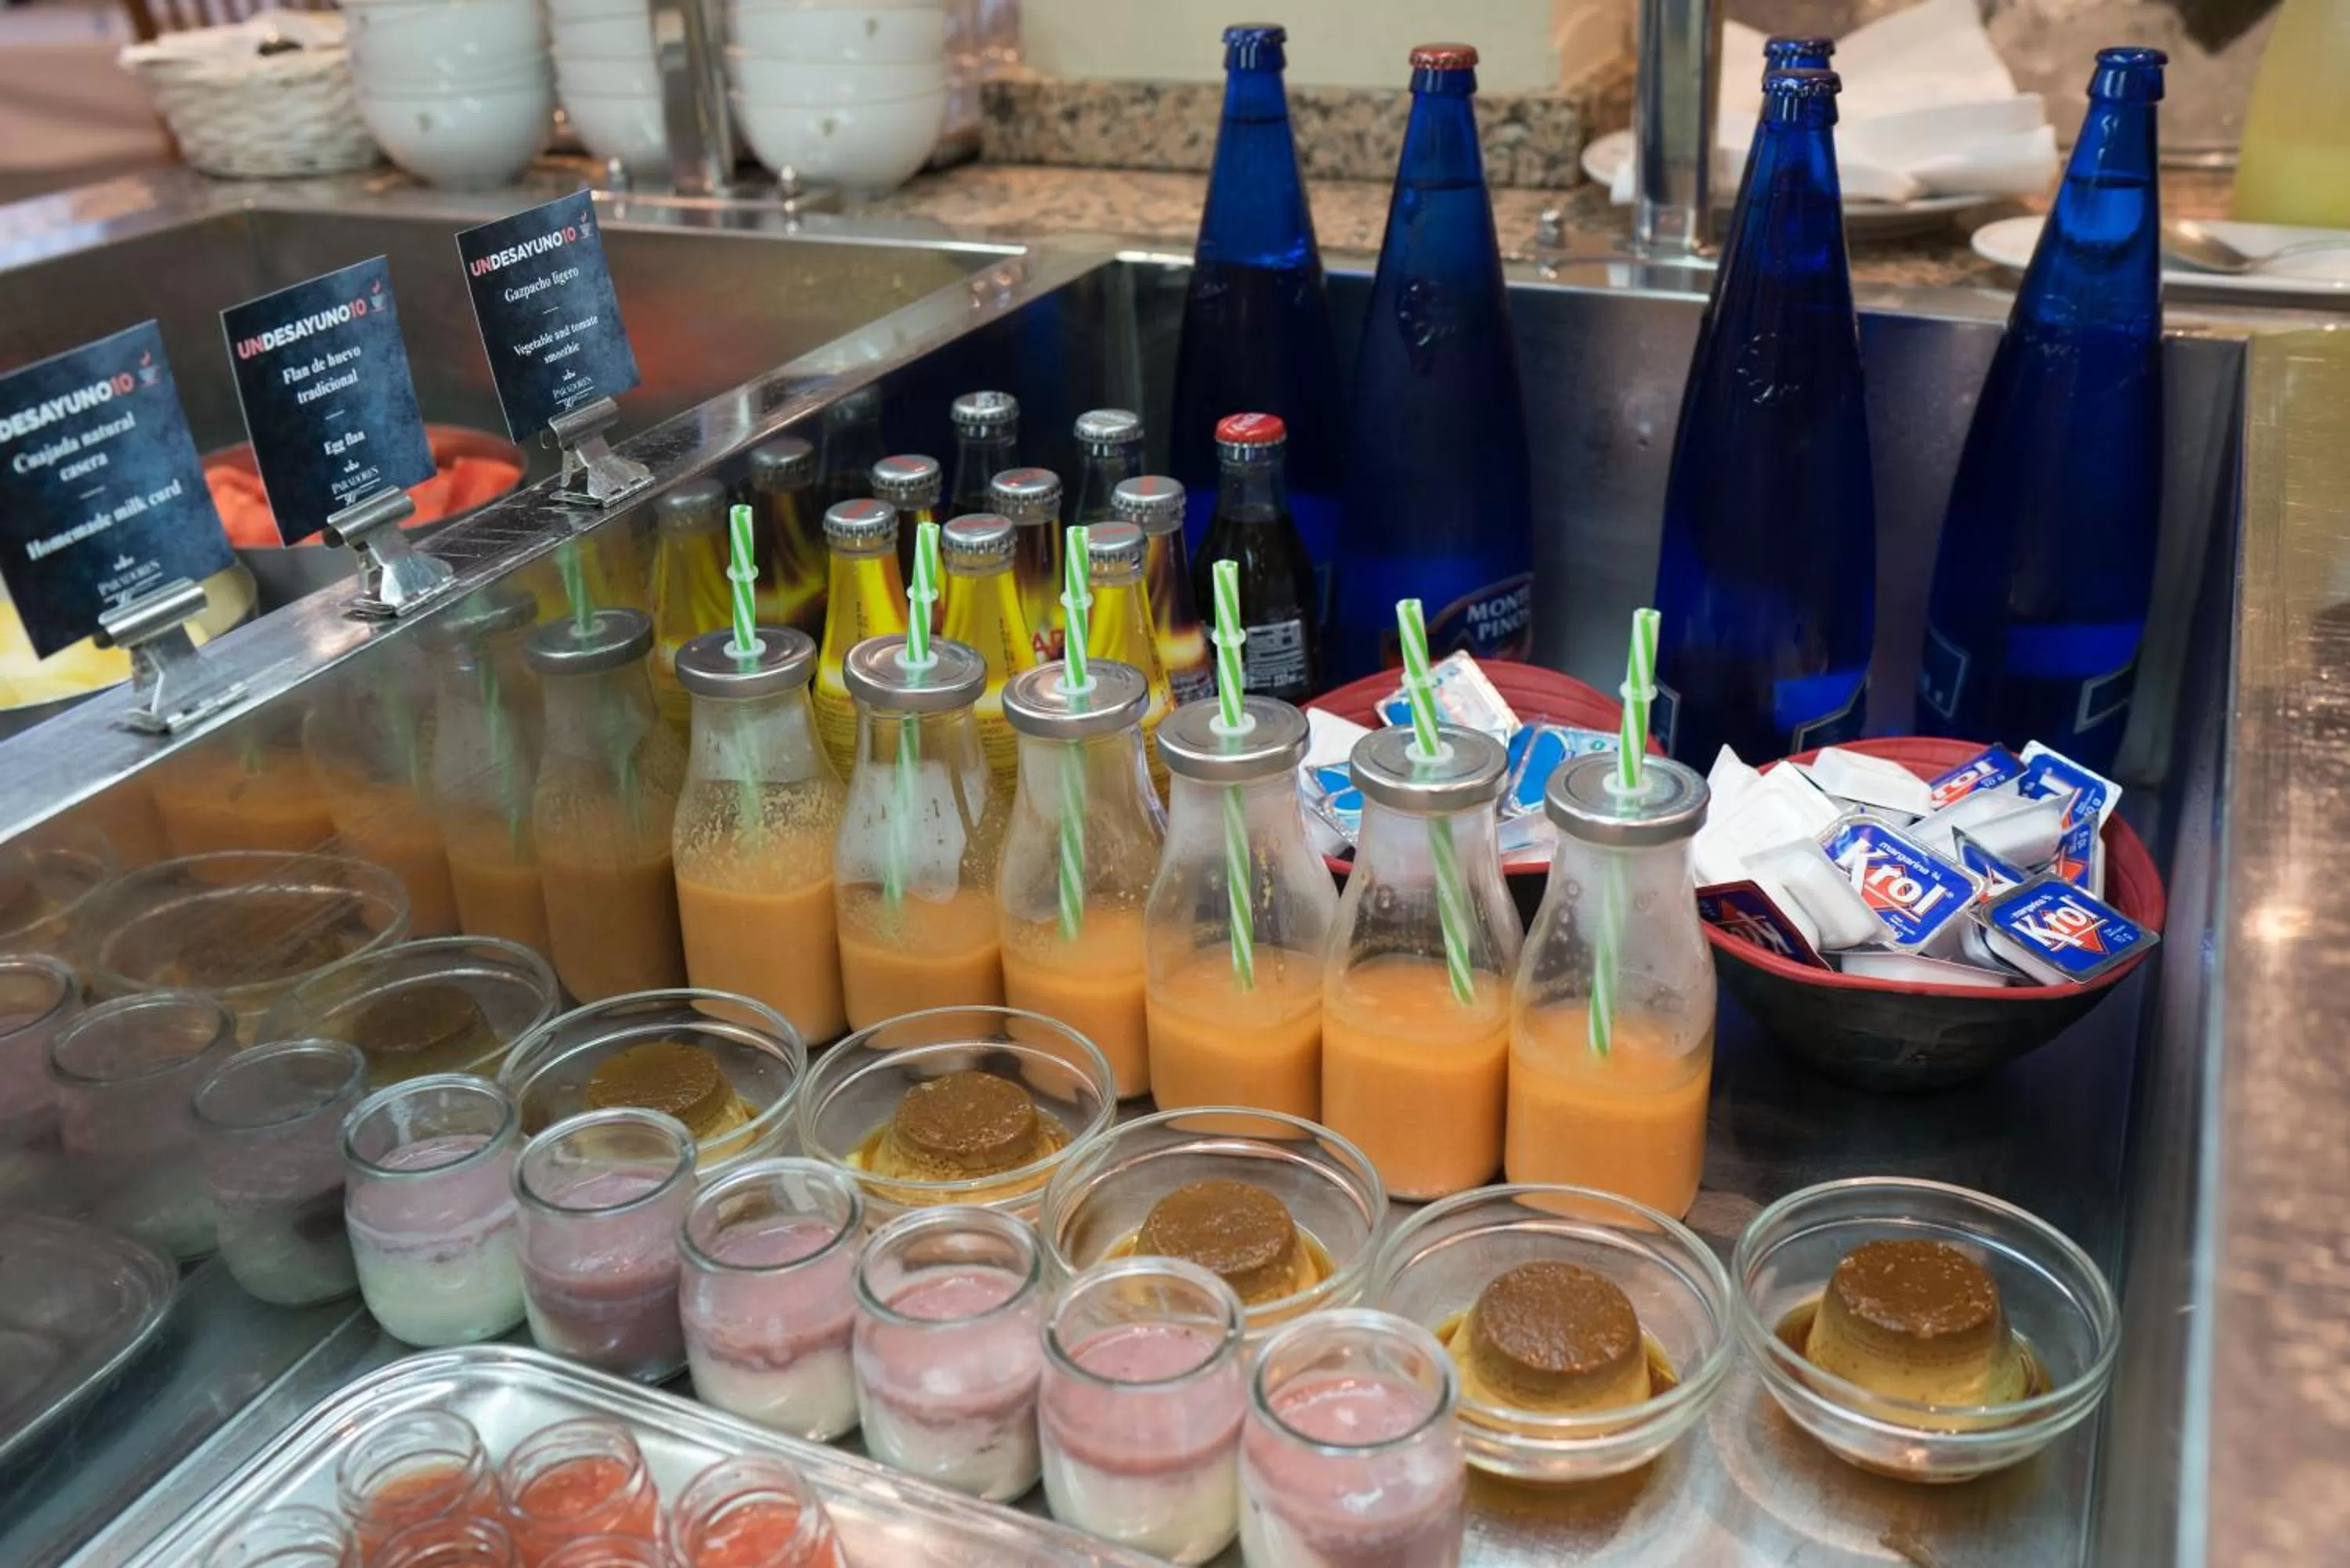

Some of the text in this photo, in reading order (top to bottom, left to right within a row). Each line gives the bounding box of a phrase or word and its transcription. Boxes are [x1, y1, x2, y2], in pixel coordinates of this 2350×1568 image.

[470, 226, 577, 276] UNDESAYUNO10
[504, 266, 579, 302] Gazpacho ligero
[237, 298, 367, 359] UNDESAYUNO10
[513, 332, 553, 356] Vegetable
[554, 323, 570, 341] and
[282, 344, 361, 385] Flan de huevo
[544, 341, 580, 364] smoothie
[297, 368, 358, 405] tradicional
[13, 410, 136, 475] Cuajada natural
[324, 429, 366, 456] Egg flan
[26, 478, 183, 562] Homemade milk curd
[1931, 761, 1994, 803] rol
[1835, 836, 1949, 917] Krol
[2011, 894, 2098, 948] Krol
